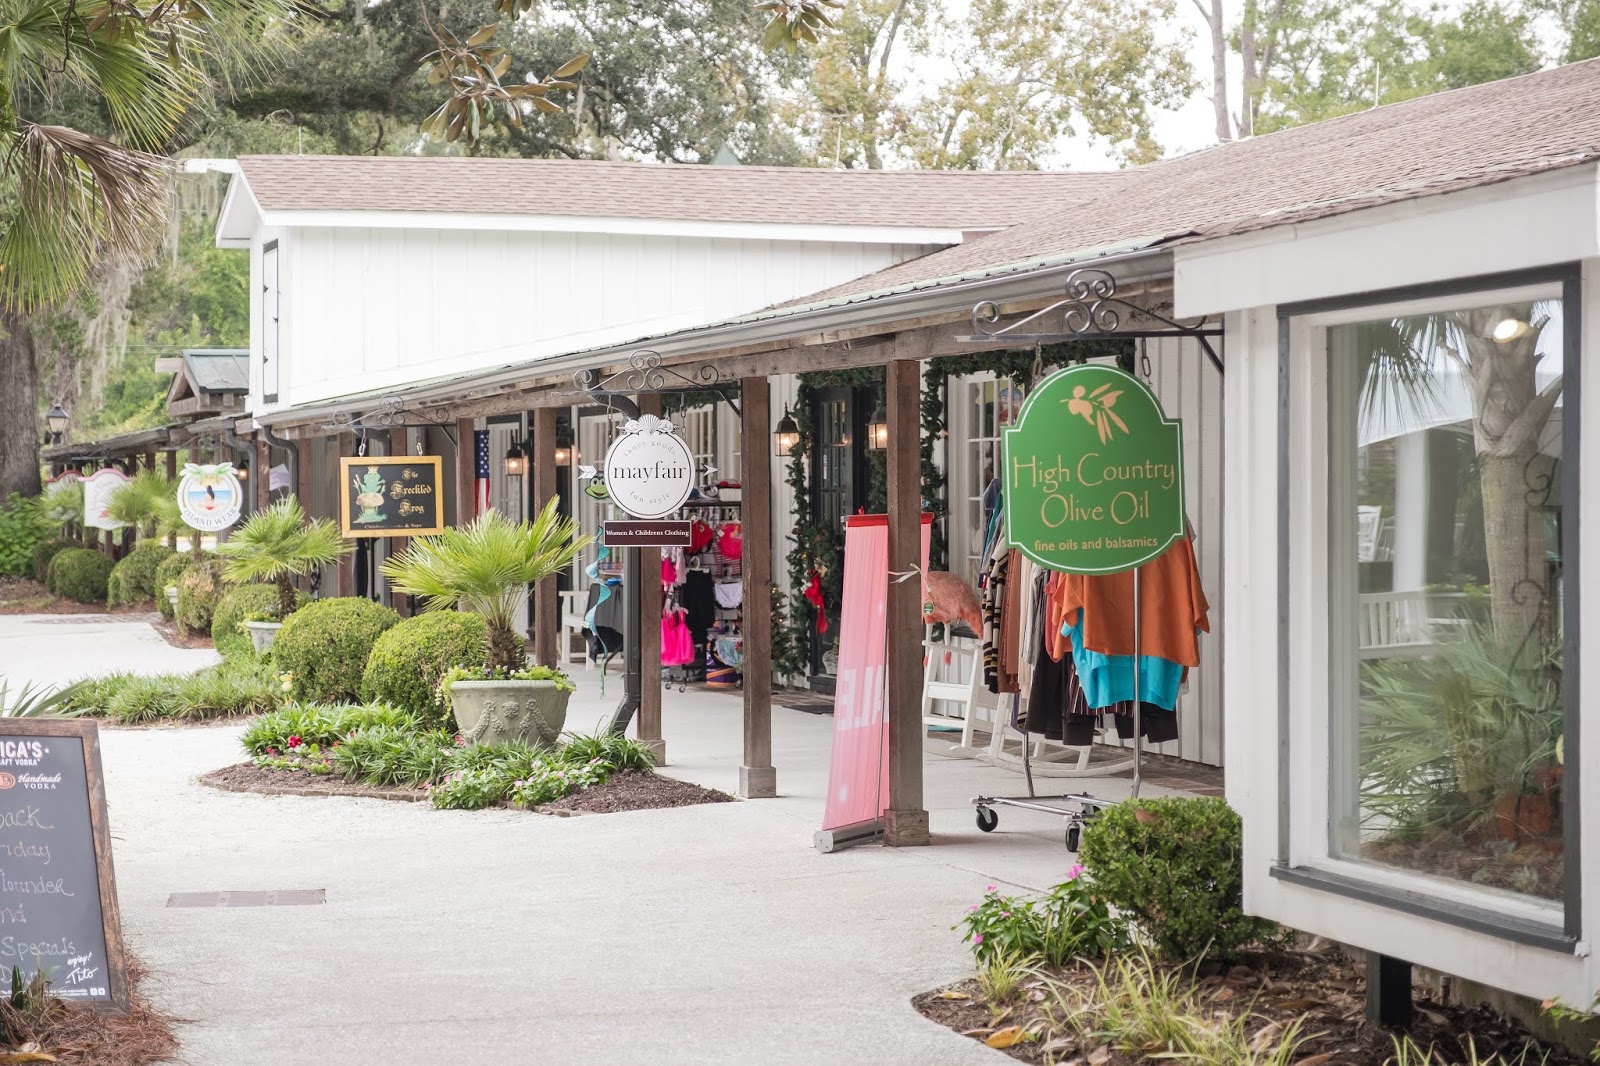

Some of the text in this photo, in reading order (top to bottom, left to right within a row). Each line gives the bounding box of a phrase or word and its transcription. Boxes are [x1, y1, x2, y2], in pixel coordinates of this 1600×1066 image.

[623, 441, 676, 456] fancy goods
[402, 468, 419, 480] The
[614, 460, 687, 483] mayfair
[1013, 452, 1175, 493] High Country
[389, 480, 432, 499] Freckled
[183, 508, 211, 526] ISLAND
[213, 507, 237, 525] WEAR
[398, 499, 425, 517] Frog
[1041, 490, 1149, 528] Olive Oil
[664, 529, 690, 538] Clothing
[1034, 536, 1158, 551] fine oils and balsamics
[17, 772, 62, 783] Handmade
[1, 935, 76, 961] Specials
